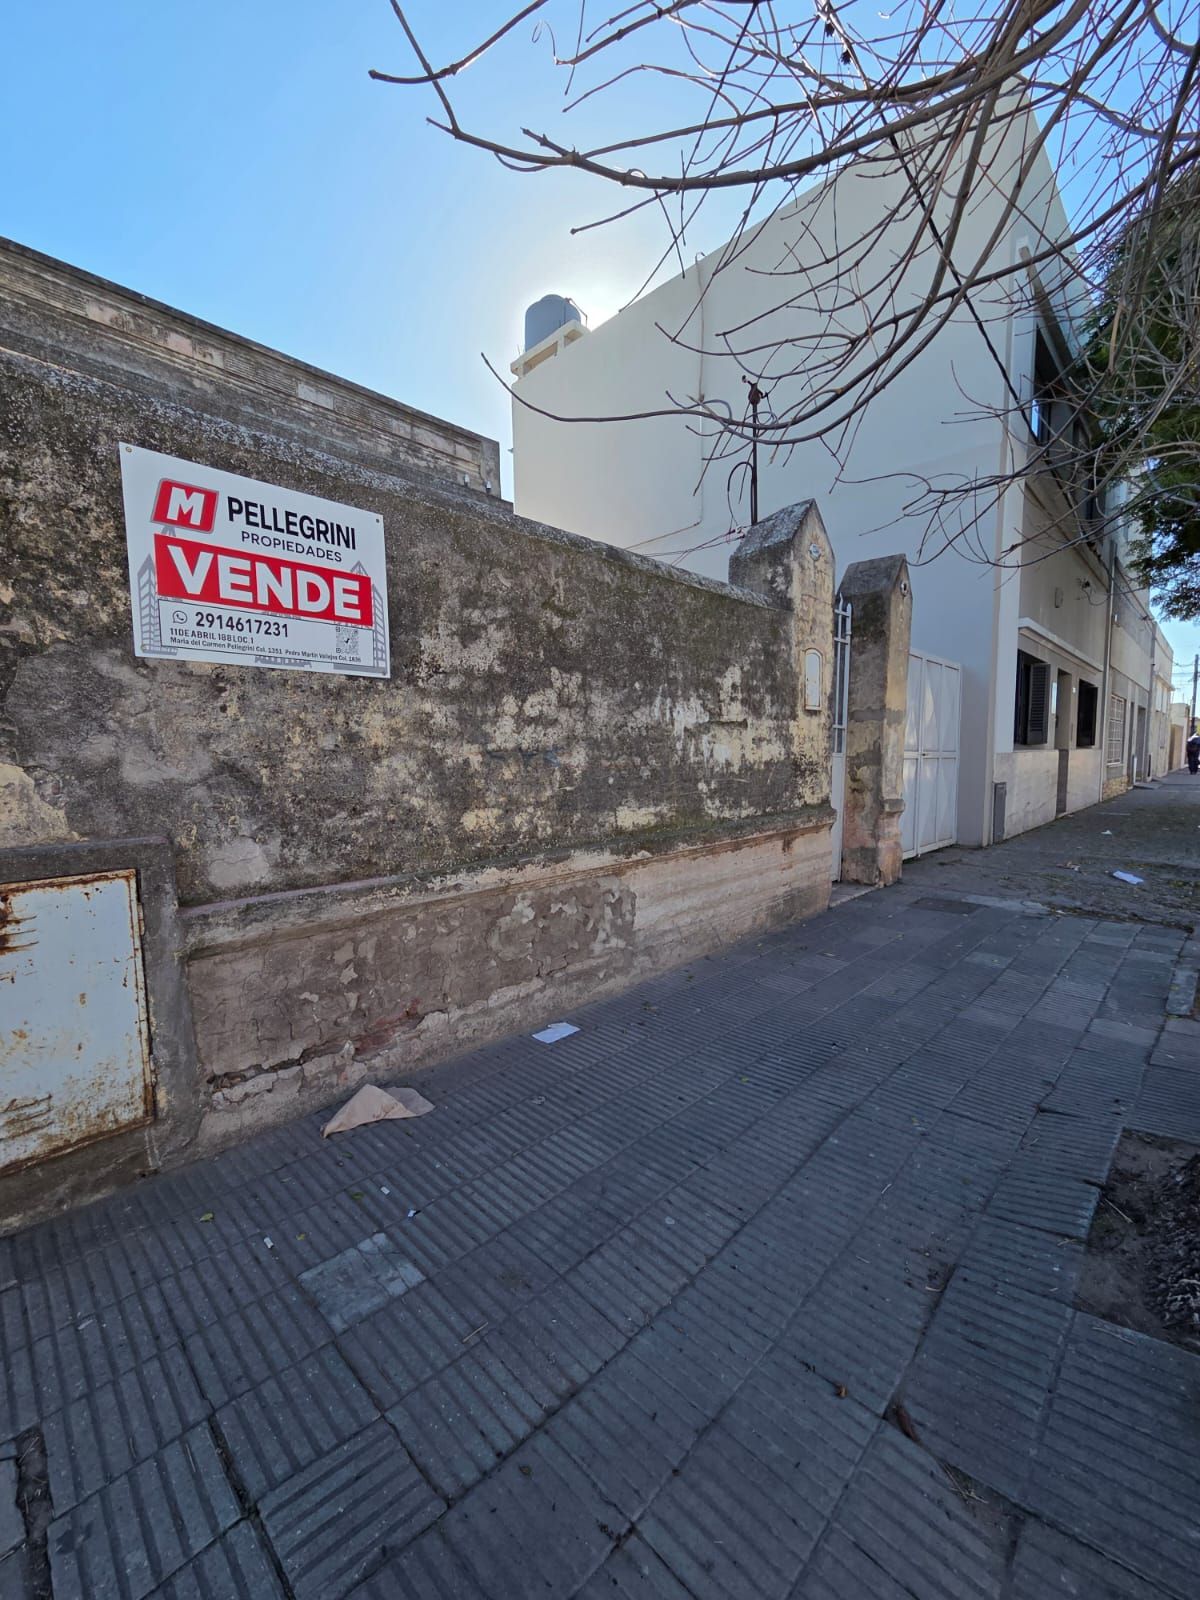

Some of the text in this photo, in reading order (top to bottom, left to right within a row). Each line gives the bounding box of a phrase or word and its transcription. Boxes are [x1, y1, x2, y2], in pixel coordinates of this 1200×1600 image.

[166, 486, 205, 526] M
[227, 496, 356, 550] PELLEGRINI
[241, 530, 342, 563] PROPIEDADES
[168, 544, 361, 620] VENDE
[191, 632, 216, 640] ABRIL
[195, 612, 289, 638] 2914617231
[227, 643, 255, 652] Pellegrini
